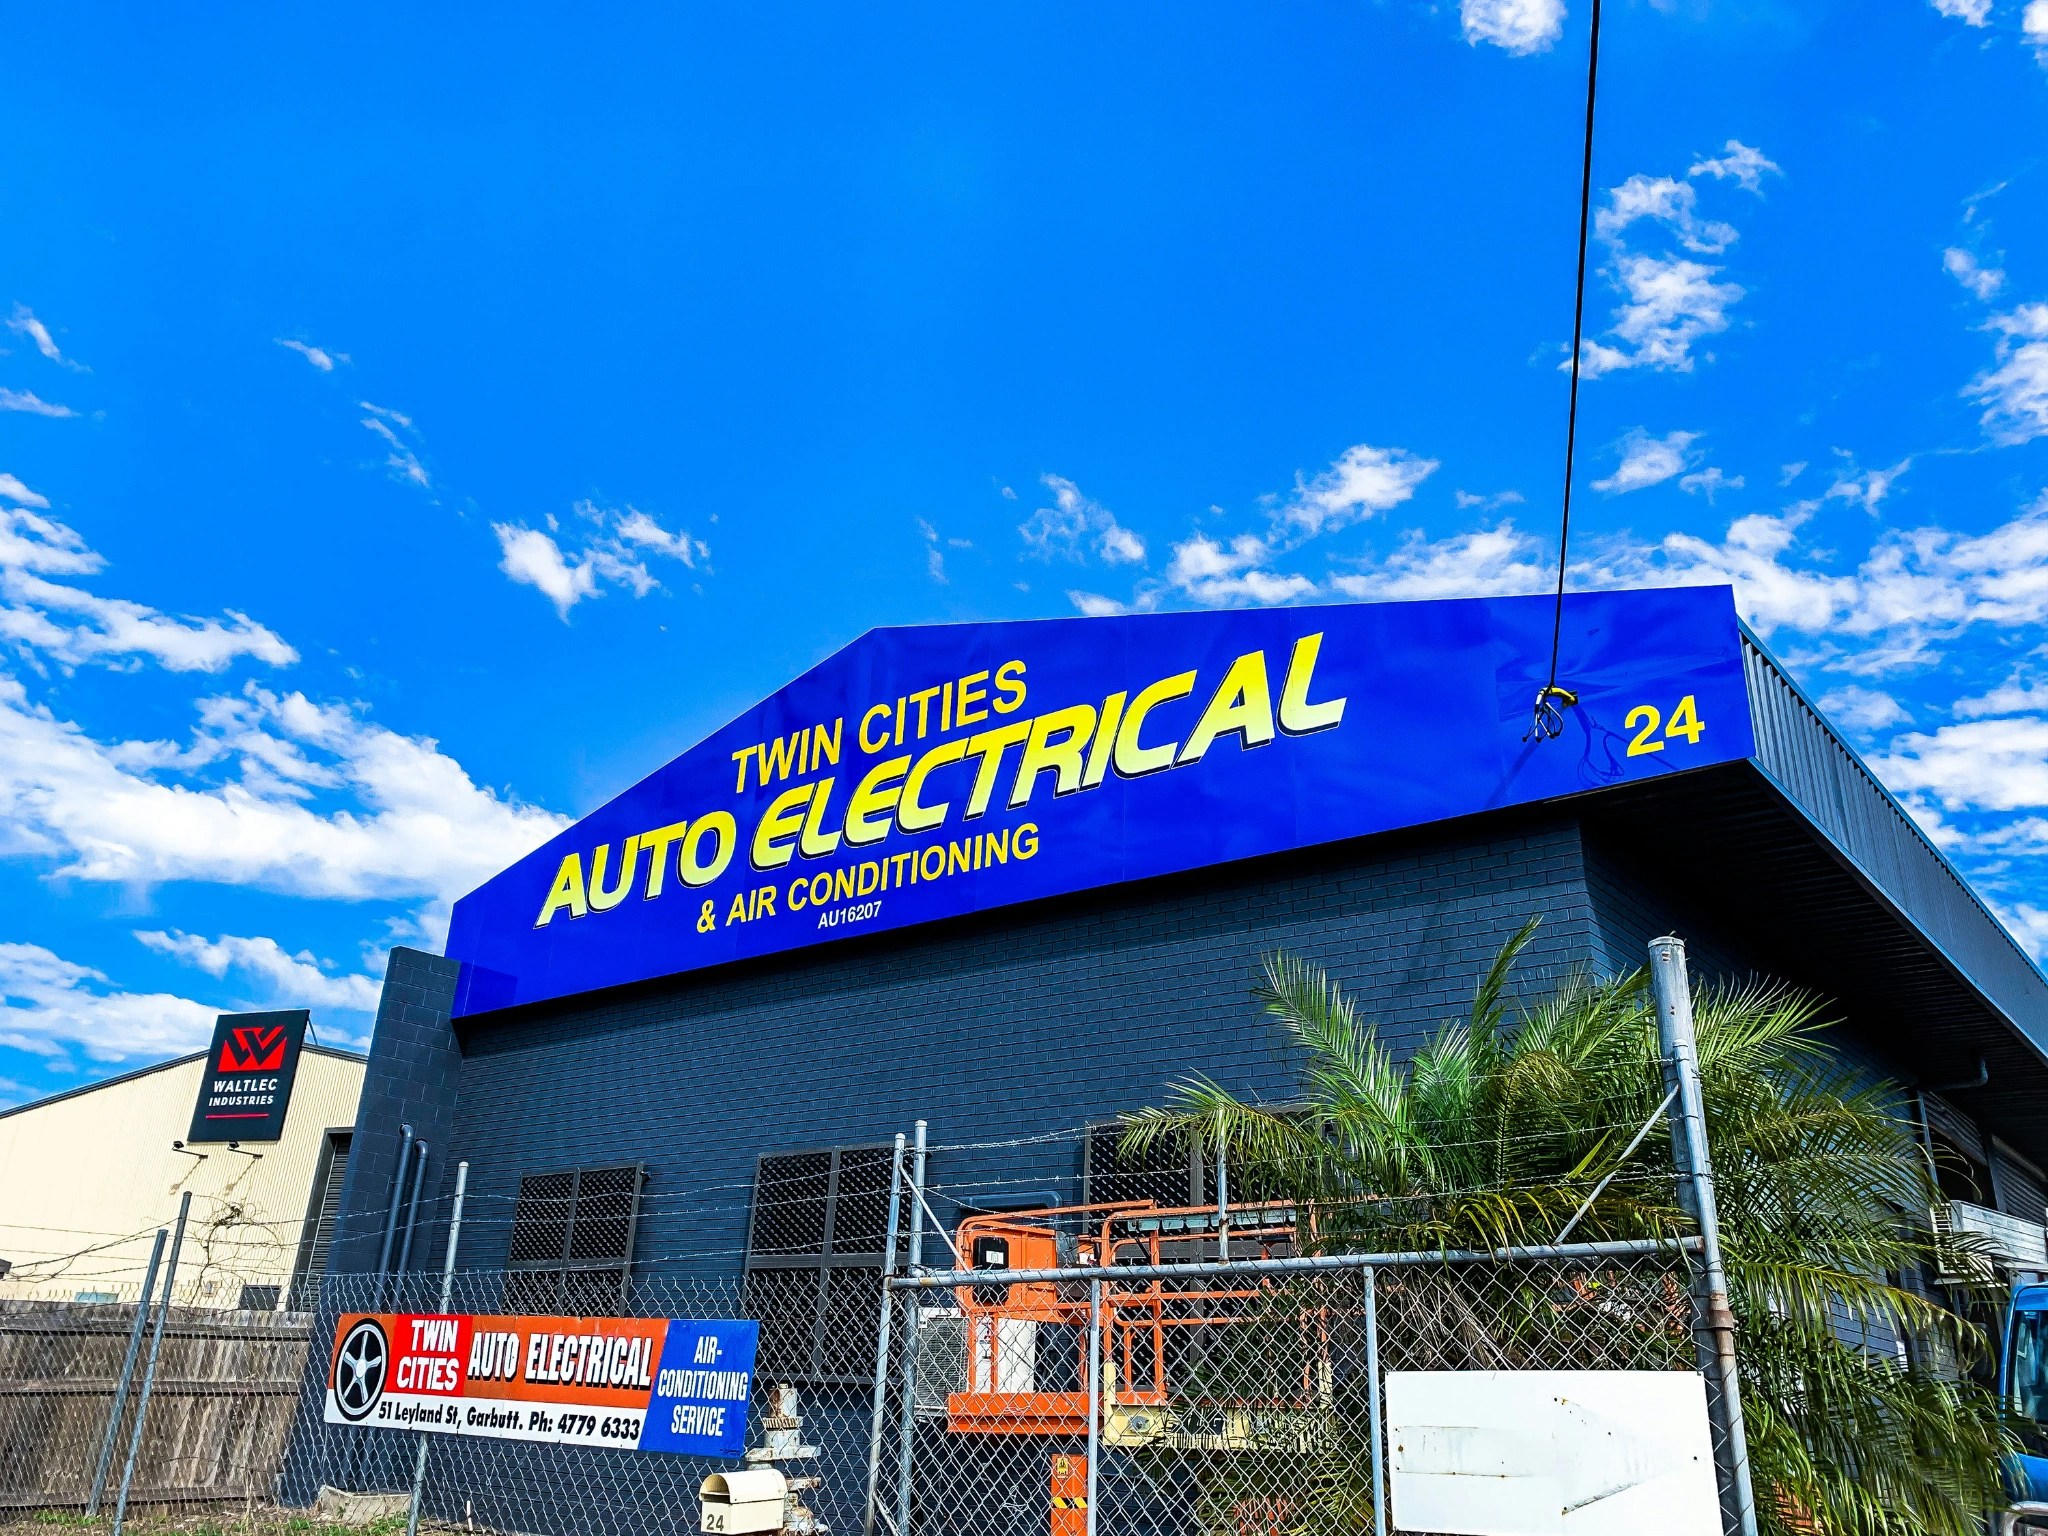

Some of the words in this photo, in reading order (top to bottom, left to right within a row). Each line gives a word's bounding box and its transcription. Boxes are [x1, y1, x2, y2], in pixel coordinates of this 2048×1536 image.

[731, 717, 843, 794] TWIN
[858, 659, 1028, 754] CITIES
[1624, 694, 1706, 758] 24
[533, 810, 737, 930] AUTO
[750, 632, 1347, 873] ELECTRICAL
[696, 899, 717, 934] &
[725, 885, 777, 927] AIR
[787, 822, 1040, 912] CONDITIONING
[817, 900, 883, 930] AU16207
[208, 1095, 275, 1107] INDUSTRIES
[213, 1078, 279, 1093] WALTLEC
[411, 1319, 459, 1352] TWIN
[693, 1335, 723, 1364] AIR-
[396, 1356, 460, 1391] CITIES
[467, 1331, 520, 1381] AUTO
[524, 1332, 654, 1391] ELECTRICAL
[657, 1368, 749, 1401] CONDITIONING
[378, 1400, 392, 1420] 51
[394, 1401, 444, 1424] Leyland
[445, 1405, 462, 1430] St,
[466, 1406, 524, 1430] Garbutt.
[528, 1410, 554, 1432] Ph:
[557, 1413, 597, 1437] 4779
[600, 1416, 640, 1440] 6333
[671, 1404, 726, 1437] SERVICE
[706, 1513, 725, 1532] 24
